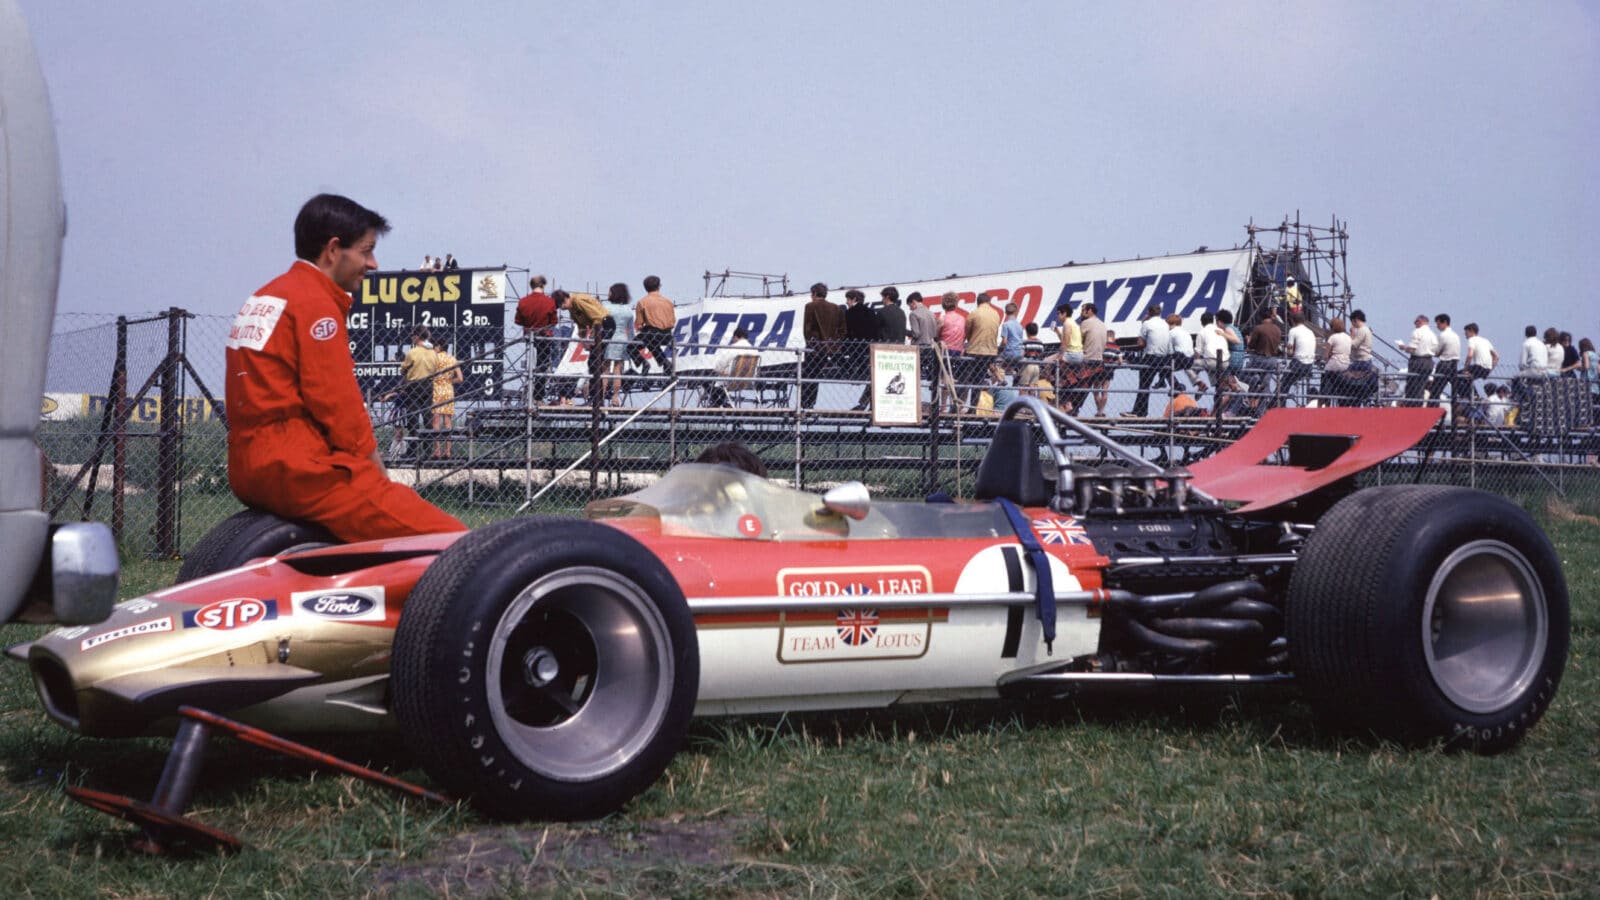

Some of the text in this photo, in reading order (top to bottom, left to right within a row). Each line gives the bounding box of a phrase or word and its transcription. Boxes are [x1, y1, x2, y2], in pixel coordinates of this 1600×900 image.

[362, 275, 461, 305] LUCAS
[1041, 268, 1230, 328] EXTRA
[314, 320, 337, 339] STP
[663, 310, 796, 358] EXTRA
[471, 365, 493, 374] LAPS
[745, 519, 755, 532] E
[1138, 524, 1172, 533] FORD
[789, 579, 922, 597] GOLD LEAF
[203, 599, 260, 628] STP
[313, 594, 361, 614] Ford
[86, 619, 169, 647] Firestone
[790, 633, 922, 652] TEAM LOTUS
